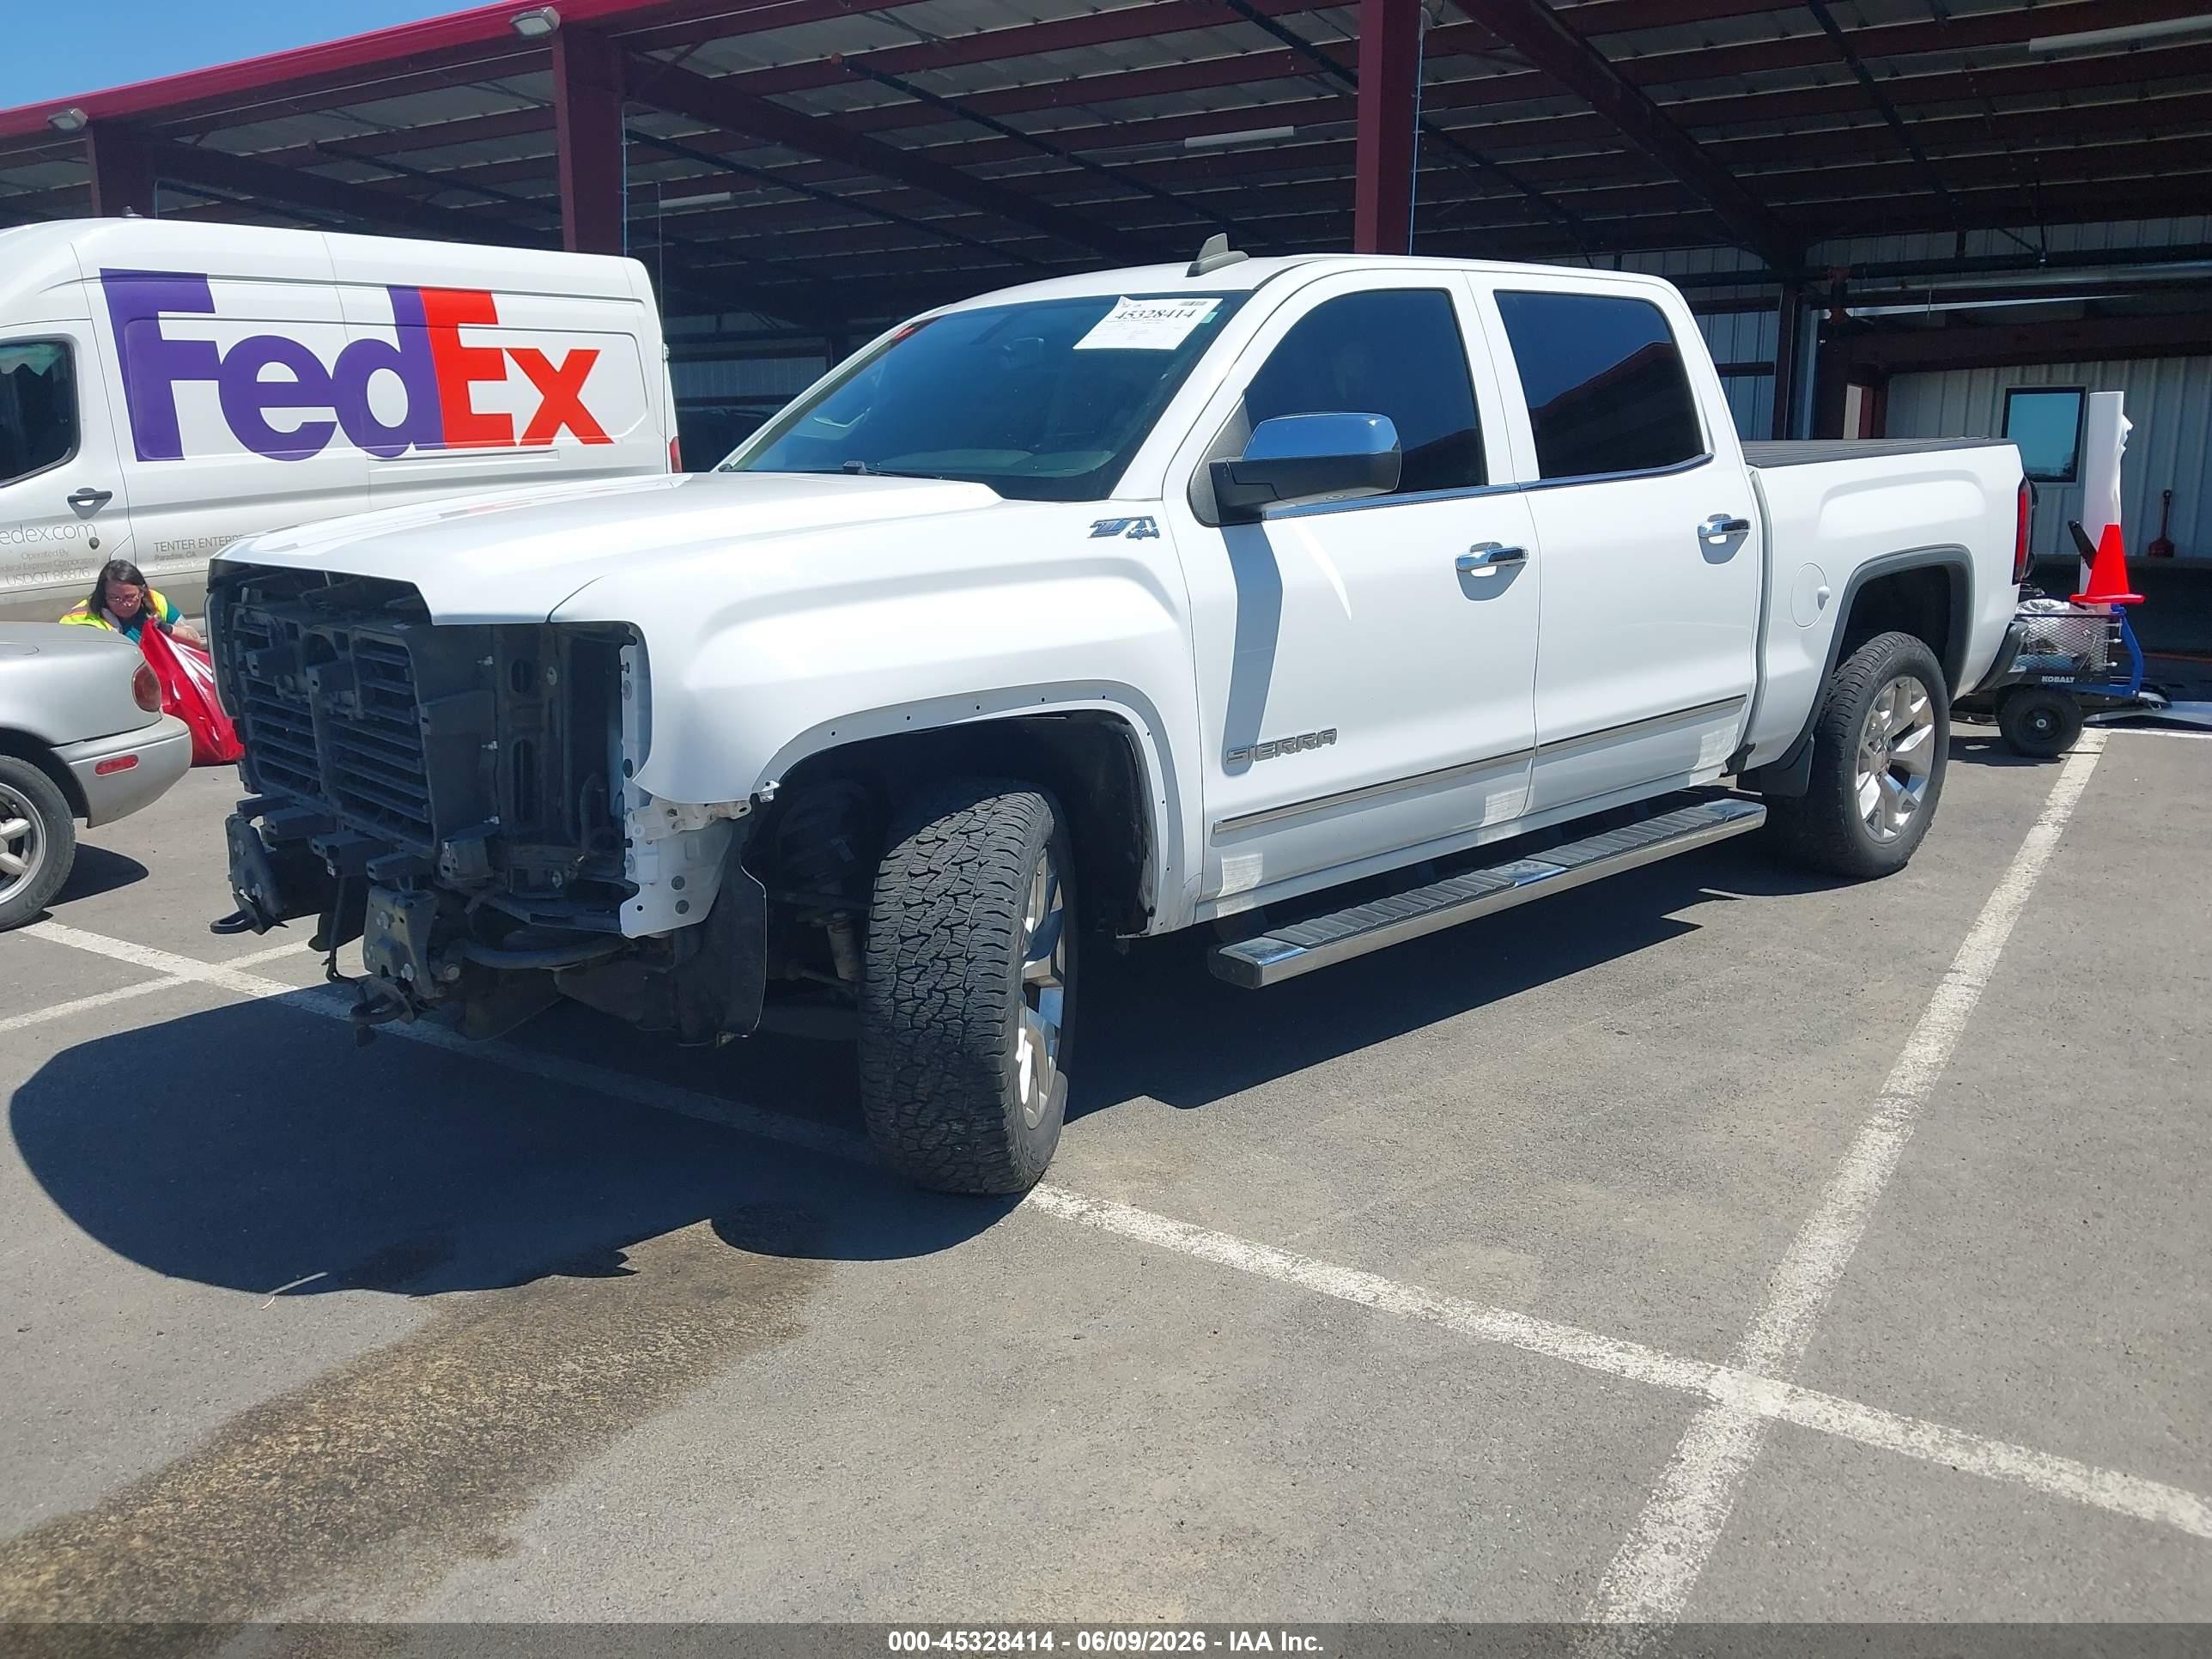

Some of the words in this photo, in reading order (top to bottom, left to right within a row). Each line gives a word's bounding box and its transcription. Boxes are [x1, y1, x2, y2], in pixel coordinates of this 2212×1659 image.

[1115, 308, 1198, 319] 45328414
[100, 268, 614, 462] FedEx
[0, 524, 97, 544] edex.com
[153, 538, 196, 551] TENTER
[6, 571, 50, 585] USDOT
[53, 567, 90, 580] 86876
[2041, 675, 2075, 684] KOBALT
[1226, 728, 1337, 764] SIERRA
